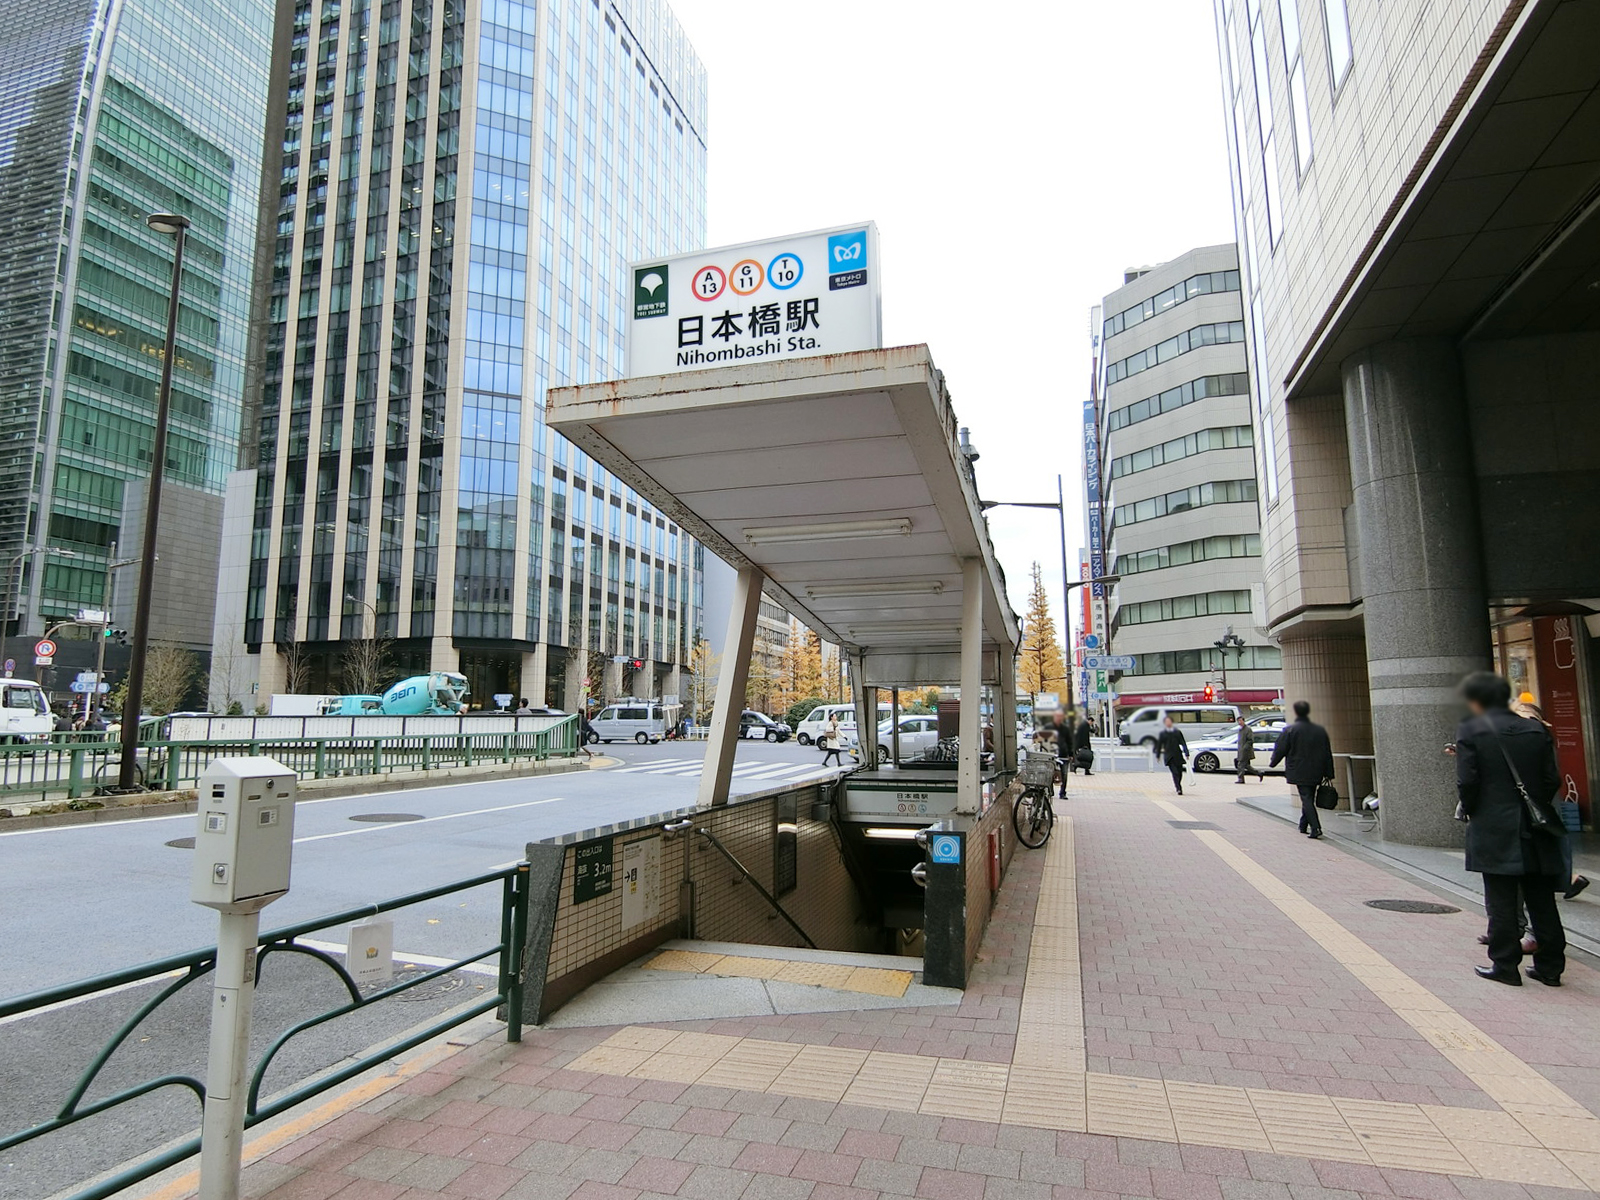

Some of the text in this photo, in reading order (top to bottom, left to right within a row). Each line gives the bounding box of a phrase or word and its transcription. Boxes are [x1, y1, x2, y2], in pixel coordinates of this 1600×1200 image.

[782, 259, 789, 269] T
[741, 265, 752, 276] G
[778, 270, 794, 282] 10
[704, 271, 714, 282] A
[739, 277, 753, 288] 11
[702, 283, 717, 294] 13
[677, 297, 820, 349] 日本橋駅
[677, 336, 821, 366] Nihombashi Sta.
[594, 862, 611, 877] 3.2m
